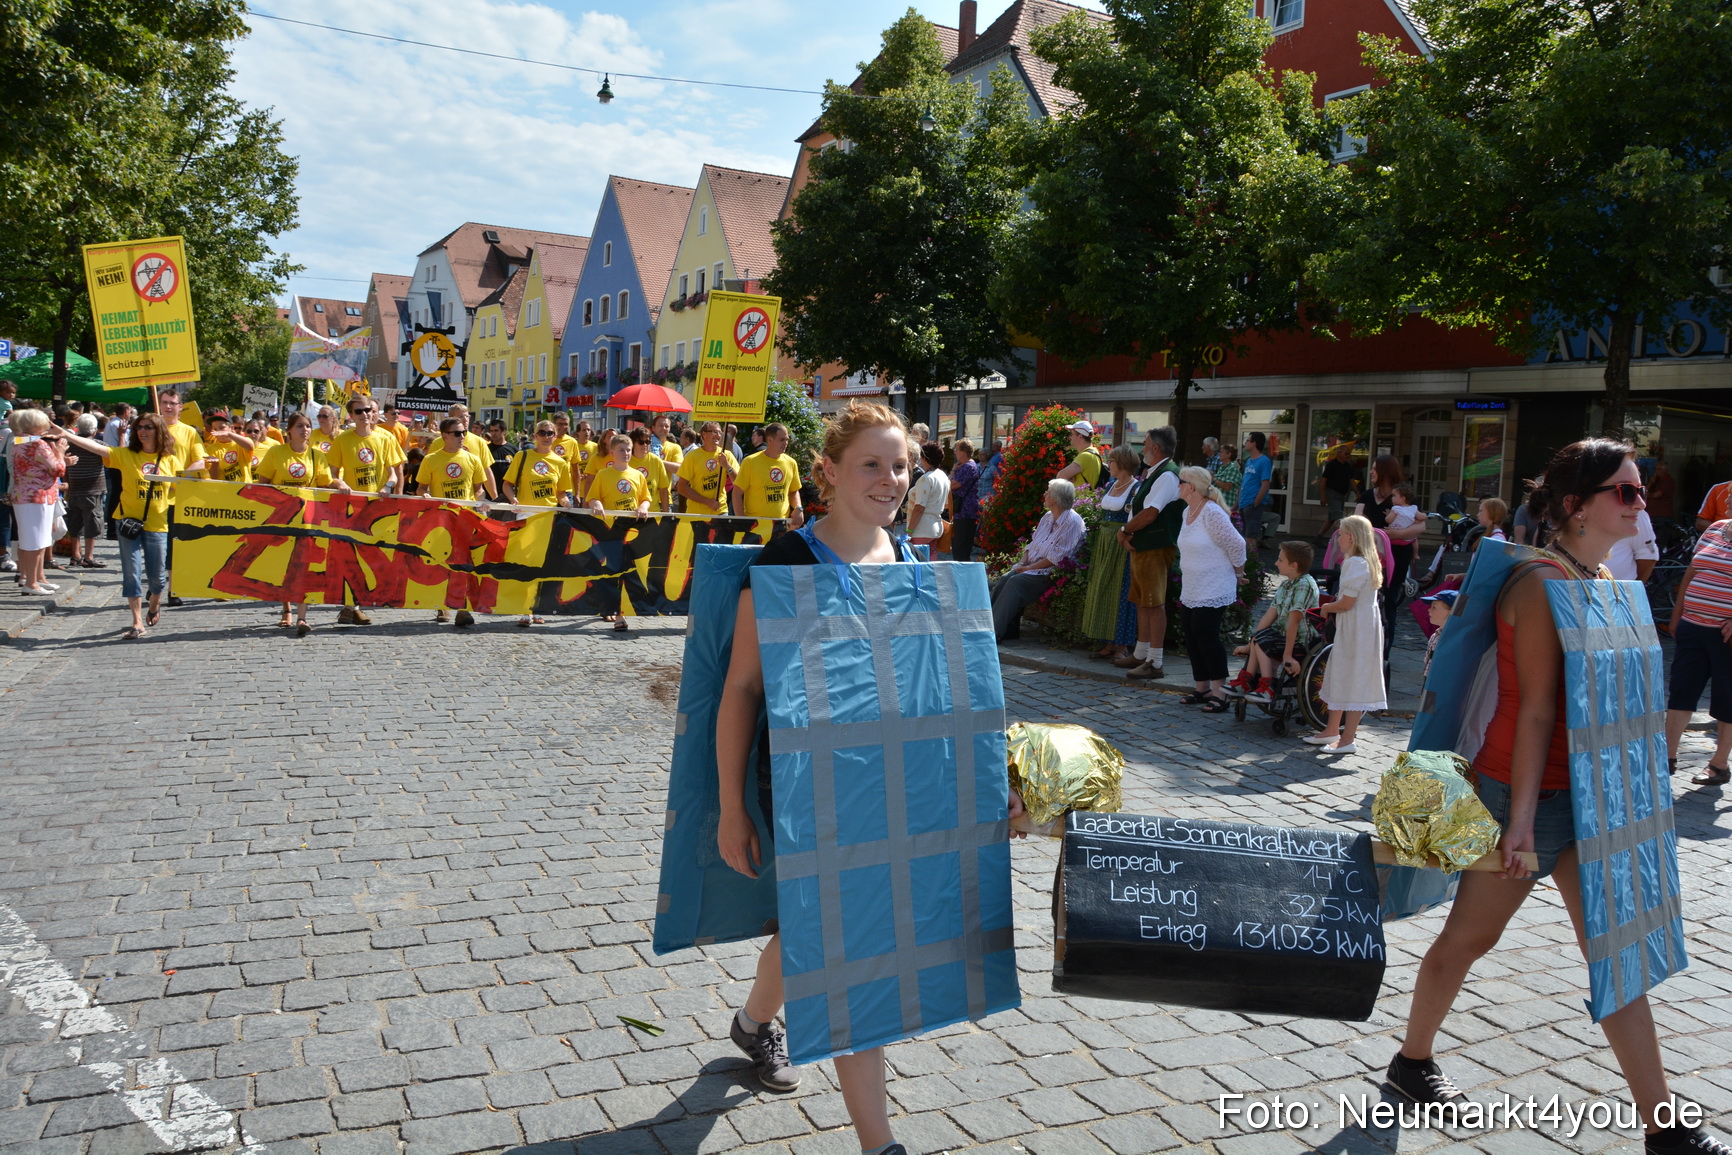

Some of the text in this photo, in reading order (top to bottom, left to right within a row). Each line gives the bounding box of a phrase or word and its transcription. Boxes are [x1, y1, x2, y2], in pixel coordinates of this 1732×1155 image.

[97, 271, 125, 287] NEIN!
[101, 310, 139, 326] HEIMAT
[103, 319, 187, 341] LEBENSQUALITÄT
[105, 337, 168, 356] GESUNDHEIT
[707, 340, 723, 359] JA
[108, 357, 155, 371] schützen!
[717, 362, 766, 373] Energiewende!
[702, 377, 735, 397] NEIN
[698, 400, 757, 409] zum Kohlestrom!
[357, 475, 378, 487] NEIN!
[445, 489, 466, 499] NEIN!
[534, 488, 553, 499] NEIN!
[767, 493, 785, 503] NEIN!
[184, 506, 256, 521] STROMTRASSE
[1077, 845, 1184, 877] Temperatur
[1110, 880, 1381, 927] Leistung 32,5 kW
[1140, 915, 1384, 961] Ertrag 131.033 kWh
